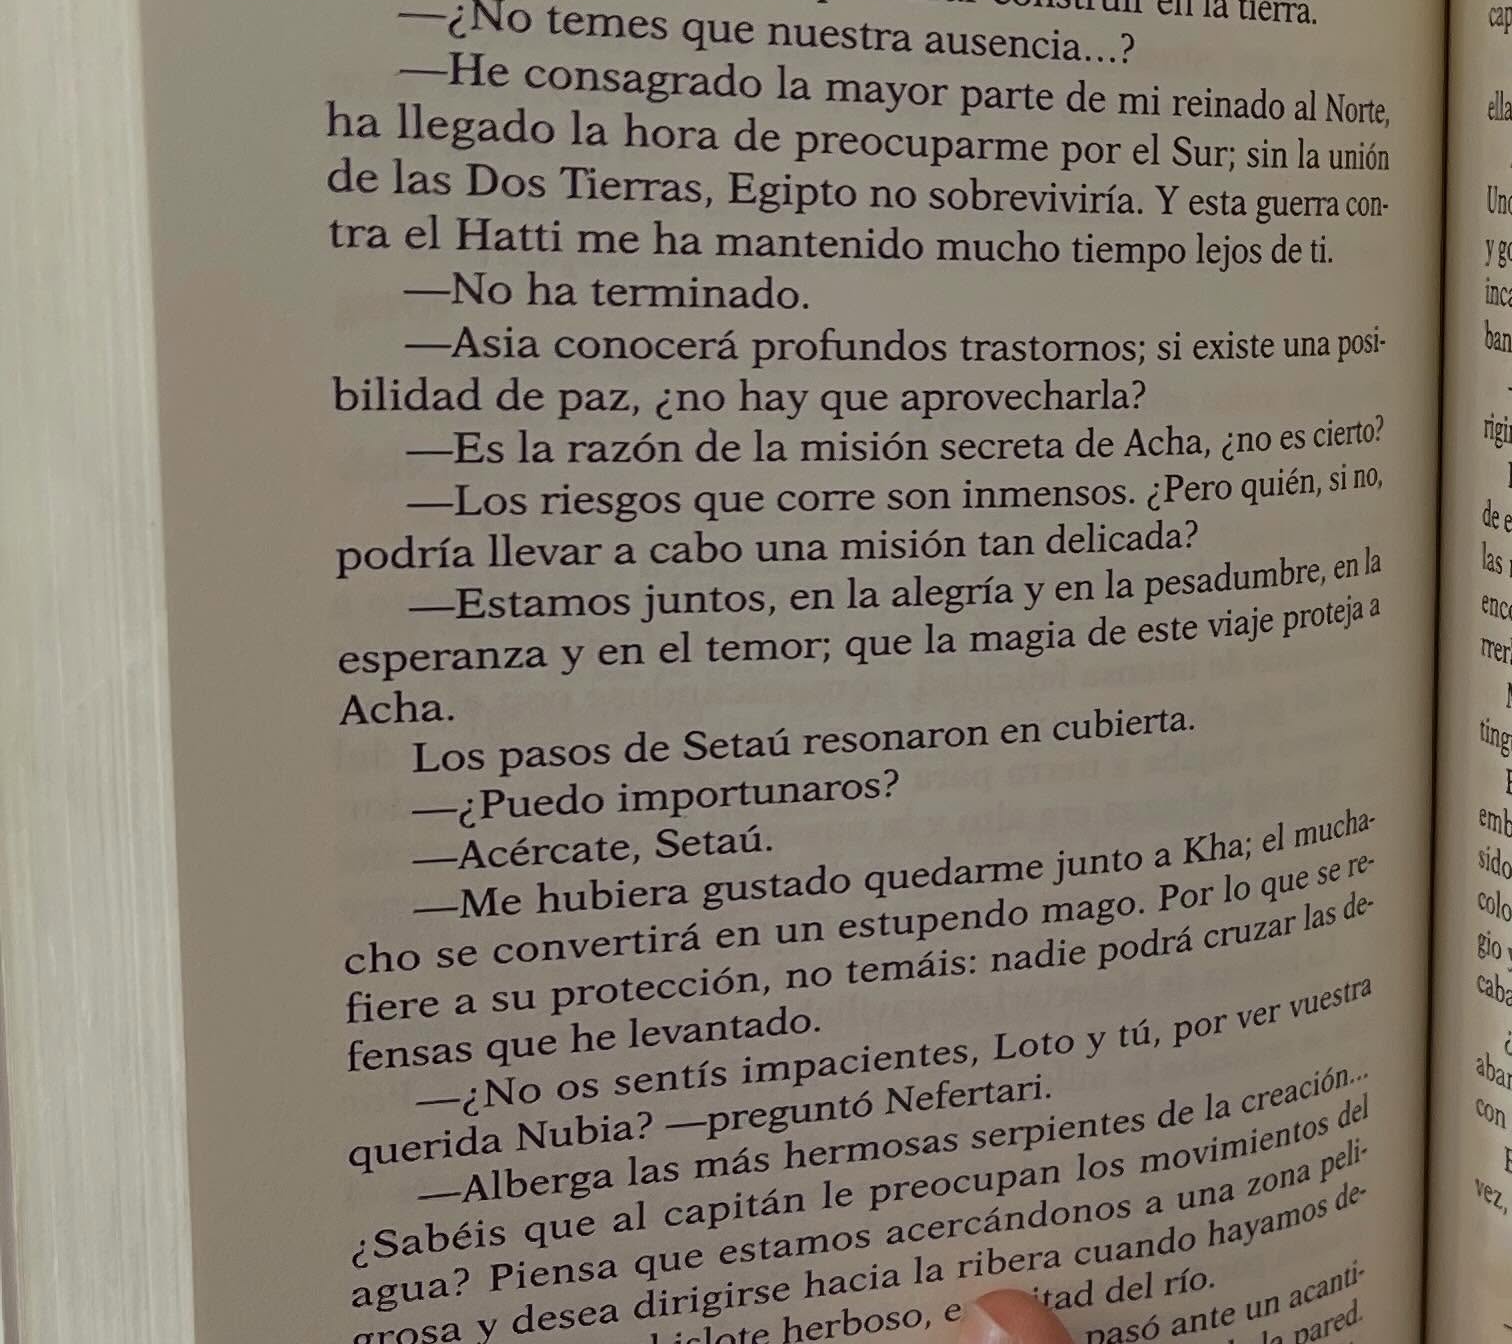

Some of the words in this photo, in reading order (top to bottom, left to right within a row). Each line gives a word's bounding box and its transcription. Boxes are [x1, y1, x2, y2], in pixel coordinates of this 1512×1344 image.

[546, 5, 668, 41] temes
[681, 18, 755, 52] que
[767, 22, 914, 53] nuestra
[526, 270, 579, 307] ha
[589, 274, 809, 310] terminado.
[1483, 318, 1512, 354] ban
[331, 375, 484, 412] bilidad
[495, 376, 545, 412] de
[556, 388, 640, 421] paz,
[655, 388, 726, 421] ¿no
[737, 377, 810, 421] hay
[819, 389, 889, 421] que
[901, 377, 1148, 419] aprovecharla?
[335, 534, 476, 580] podría
[487, 532, 603, 568] llevar
[613, 543, 638, 566] a
[649, 529, 743, 565] cabo
[754, 539, 829, 563] una
[839, 528, 968, 561] misión
[977, 530, 1036, 557] tan
[1046, 519, 1199, 555] delicada?
[411, 741, 486, 774] Los
[497, 743, 611, 779] pasos
[623, 730, 671, 764] de
[682, 727, 792, 761] Setaú
[802, 725, 990, 756] resonaron
[999, 722, 1043, 745] en
[1052, 707, 1195, 742] cubierta.
[654, 823, 773, 859] Setaú.
[348, 1124, 504, 1176] querida
[514, 1110, 654, 1152] Nubia?
[884, 1073, 1052, 1116] Nefertari.
[1474, 1177, 1508, 1216] vez,
[351, 1266, 470, 1313] agua?
[488, 1258, 620, 1293] Piensa
[633, 1248, 704, 1283] que
[718, 1228, 871, 1265] estamos
[885, 1199, 1132, 1246] acercándonos
[1144, 1195, 1165, 1216] a
[1176, 1183, 1236, 1211] una
[1247, 1163, 1312, 1197] zona
[1319, 1137, 1368, 1185] peli-
